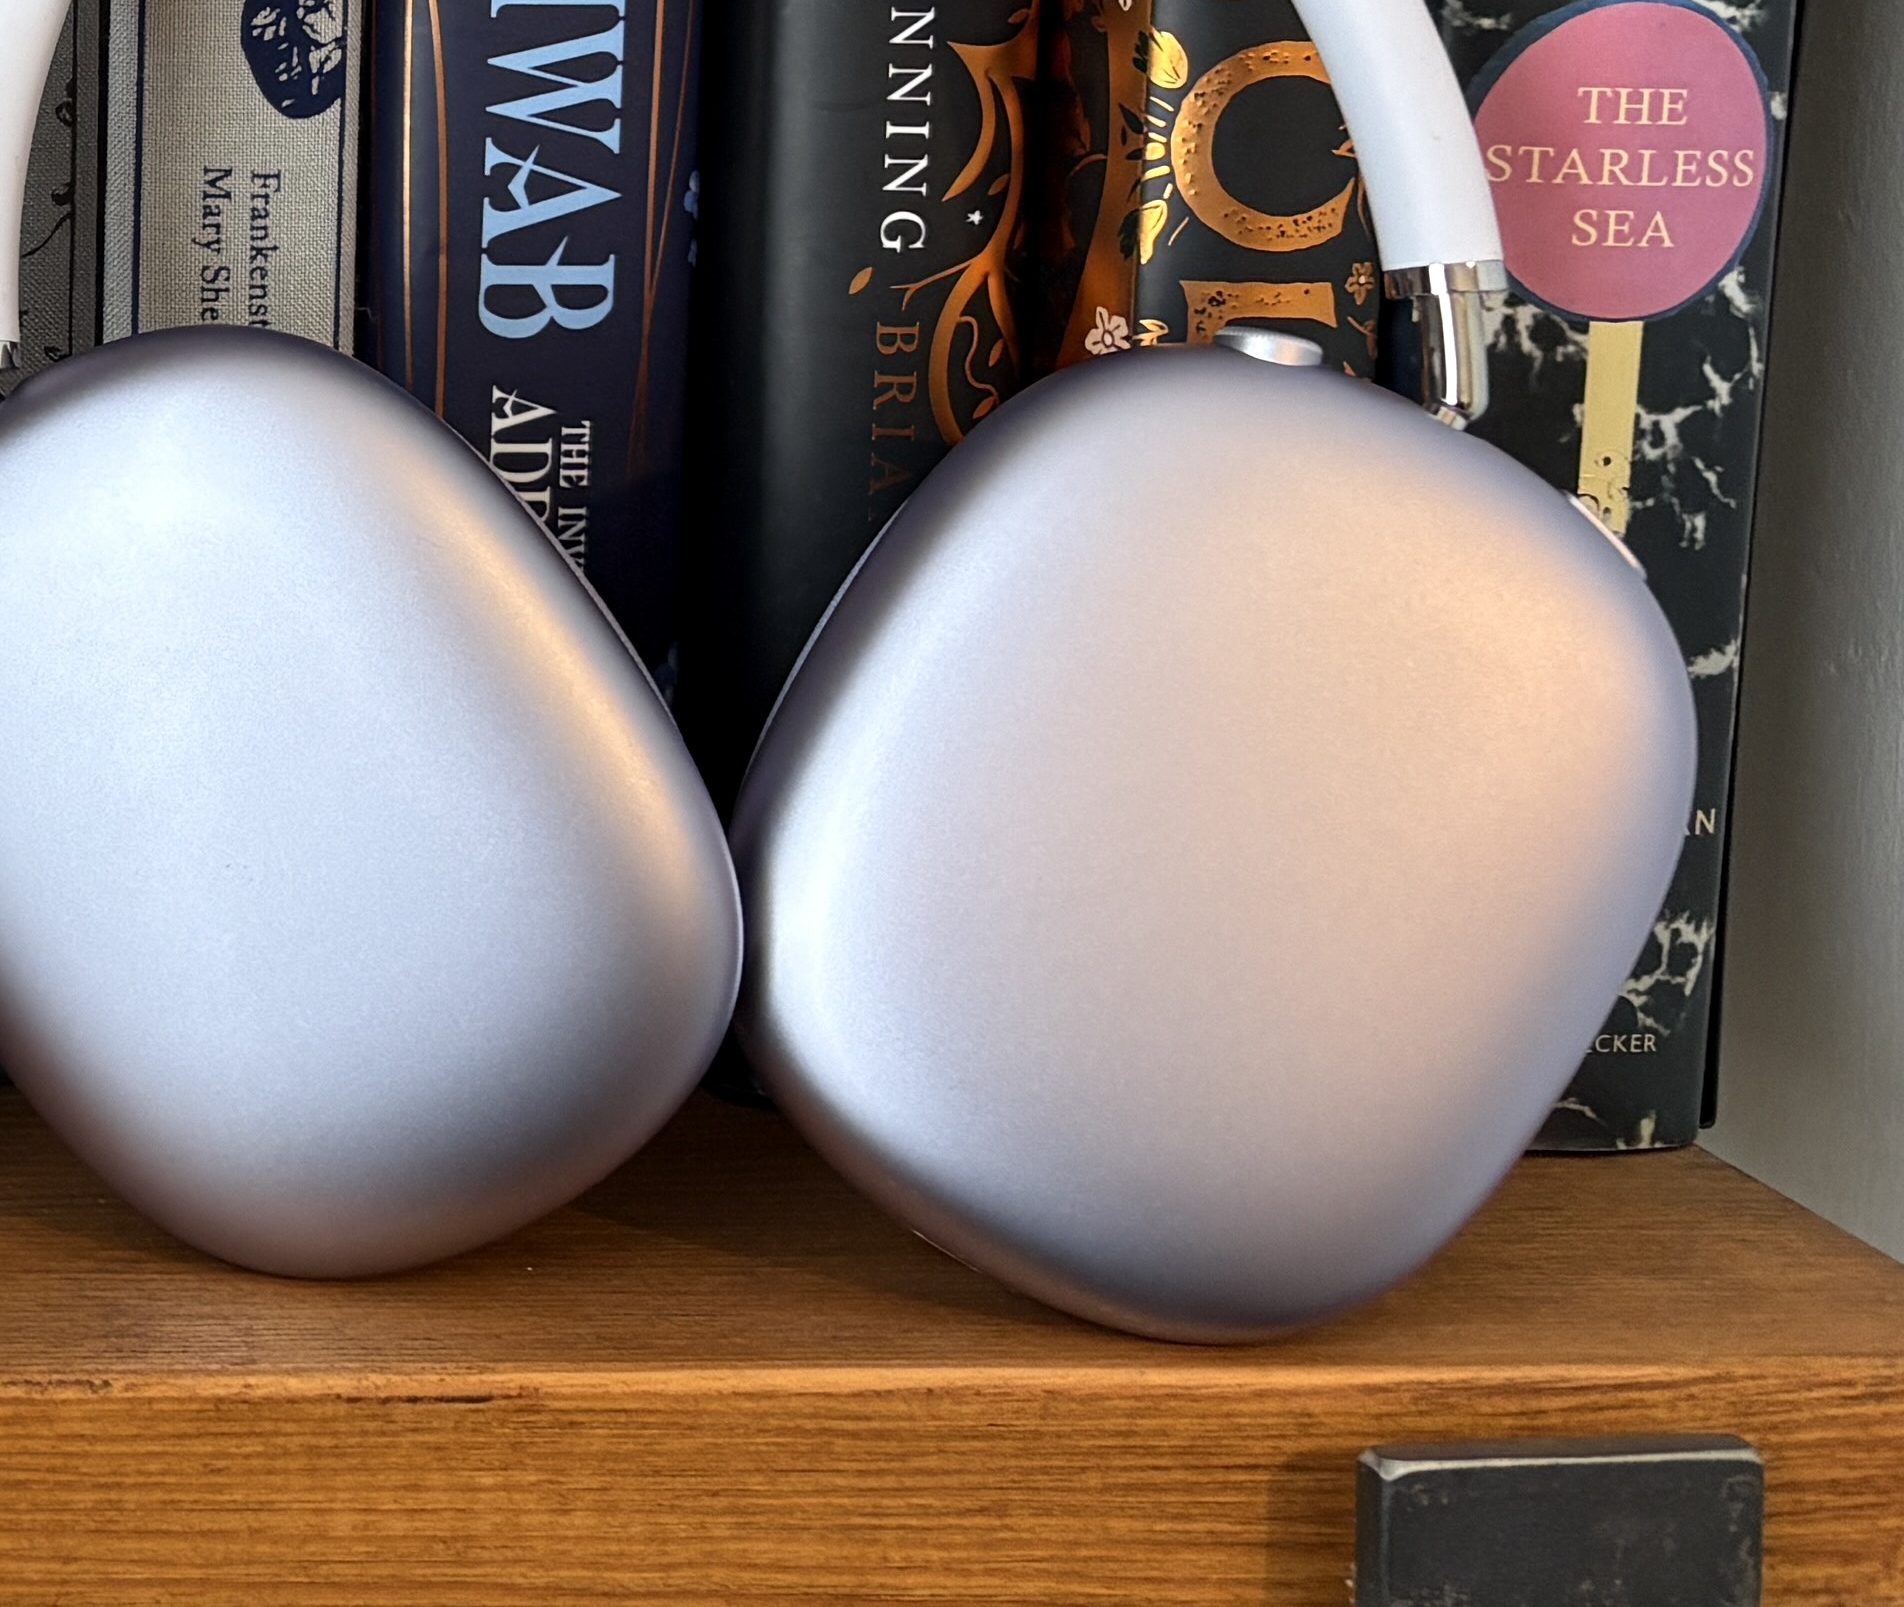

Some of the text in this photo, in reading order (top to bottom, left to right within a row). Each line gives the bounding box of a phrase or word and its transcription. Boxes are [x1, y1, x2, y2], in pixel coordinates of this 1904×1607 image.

[1577, 86, 1689, 126] THE
[1486, 144, 1755, 188] STARLESS
[192, 166, 233, 255] Mary
[1571, 209, 1675, 248] SEA
[248, 168, 282, 328] Frankenst
[867, 321, 920, 522] BRIA
[558, 420, 592, 489] THE
[1586, 1033, 1658, 1055] CKER
